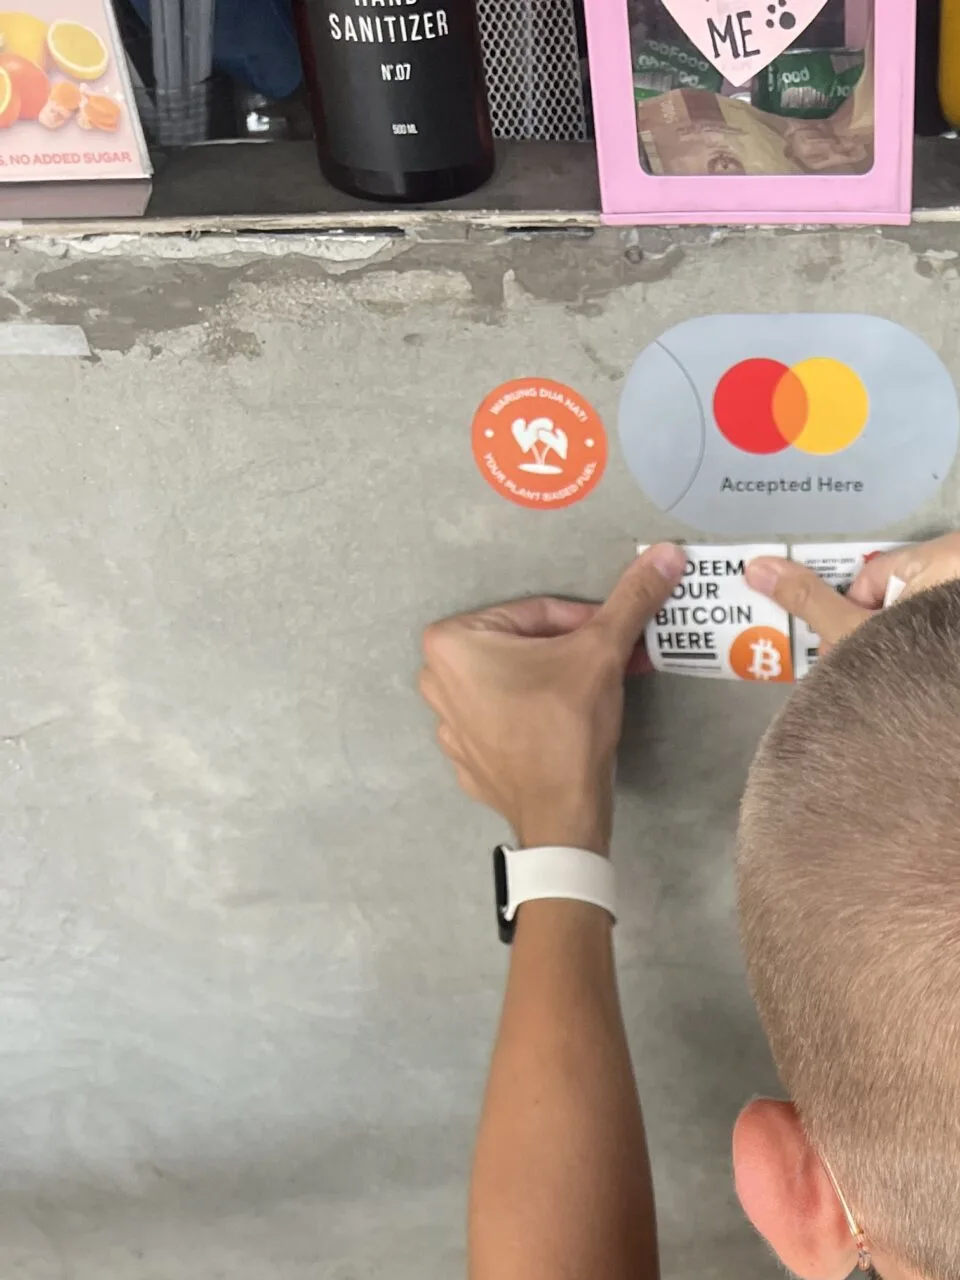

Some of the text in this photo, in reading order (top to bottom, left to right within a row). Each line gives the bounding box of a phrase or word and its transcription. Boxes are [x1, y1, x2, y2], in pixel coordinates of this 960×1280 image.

[328, 9, 449, 43] SANITIZER
[706, 11, 761, 59] ME
[9, 153, 31, 166] NO
[33, 152, 81, 165] ADDED
[83, 151, 133, 165] SUGAR
[488, 387, 538, 415] WARUNG
[538, 387, 565, 404] DUA
[483, 452, 506, 484] YOUR
[504, 479, 541, 502] PLANT
[541, 483, 579, 502] BASED
[720, 475, 864, 495] Accepted Here
[683, 559, 746, 577] DEEM
[669, 582, 720, 600] OUR
[655, 604, 753, 626] BITCOIN
[657, 631, 717, 650] HERE
